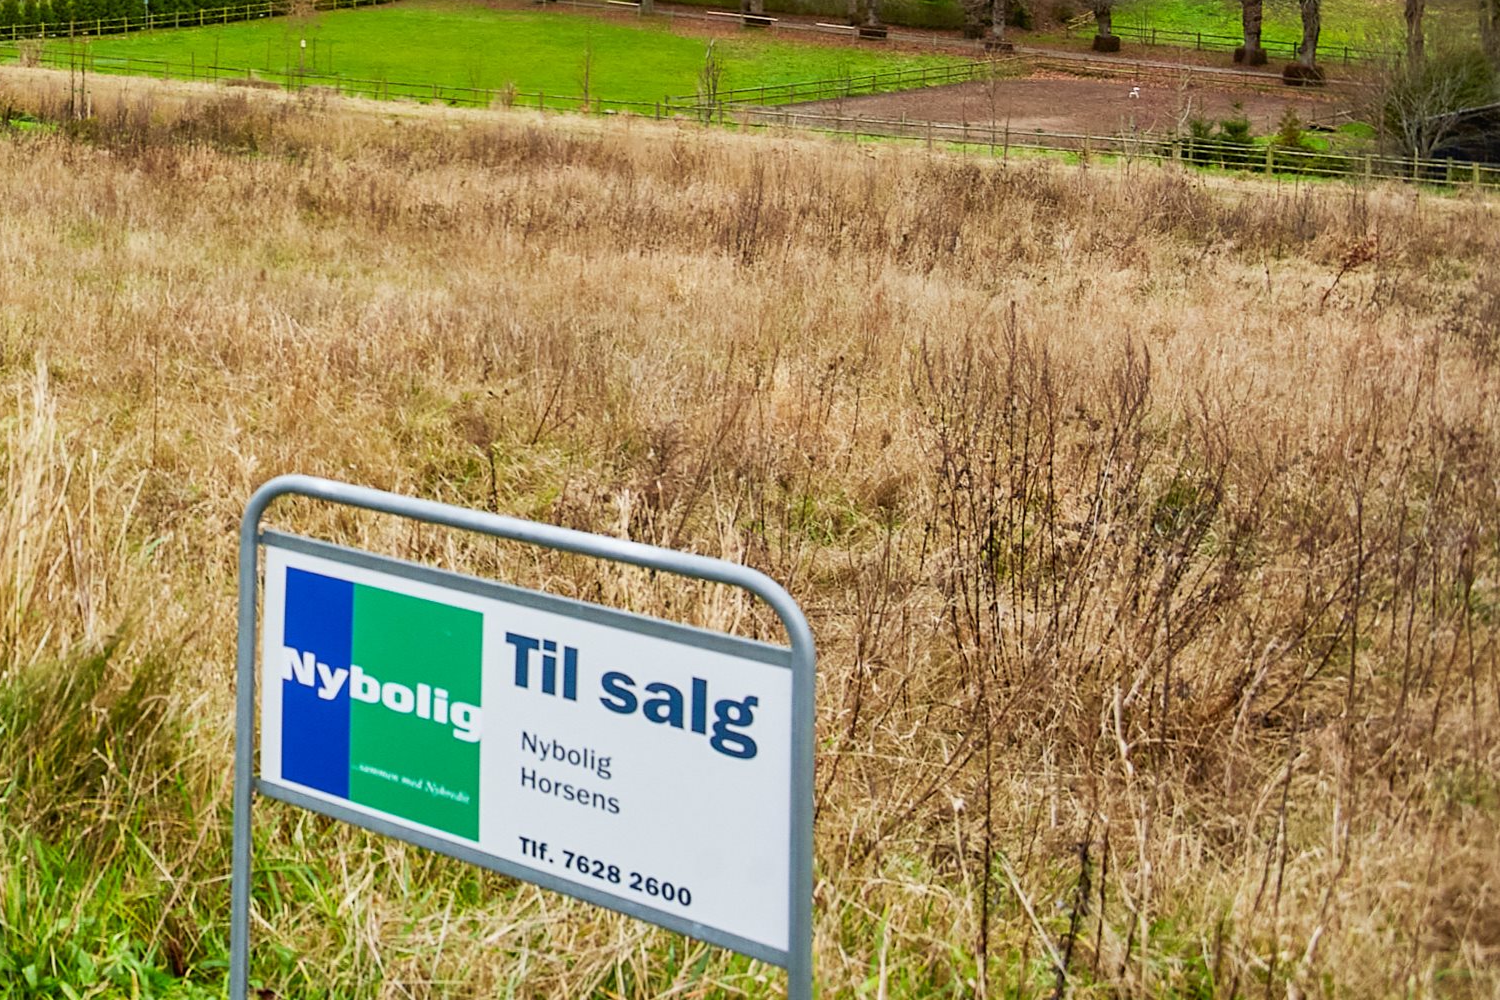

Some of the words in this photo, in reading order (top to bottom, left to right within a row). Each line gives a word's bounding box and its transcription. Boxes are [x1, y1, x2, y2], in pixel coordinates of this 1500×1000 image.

[282, 645, 483, 743] Nybolig
[505, 631, 578, 702] Til
[600, 671, 759, 760] salg
[520, 766, 620, 814] Horsens
[521, 731, 612, 780] Nybolig
[518, 836, 554, 864] Tlf.
[562, 849, 621, 884] 7628
[629, 872, 692, 906] 2600
